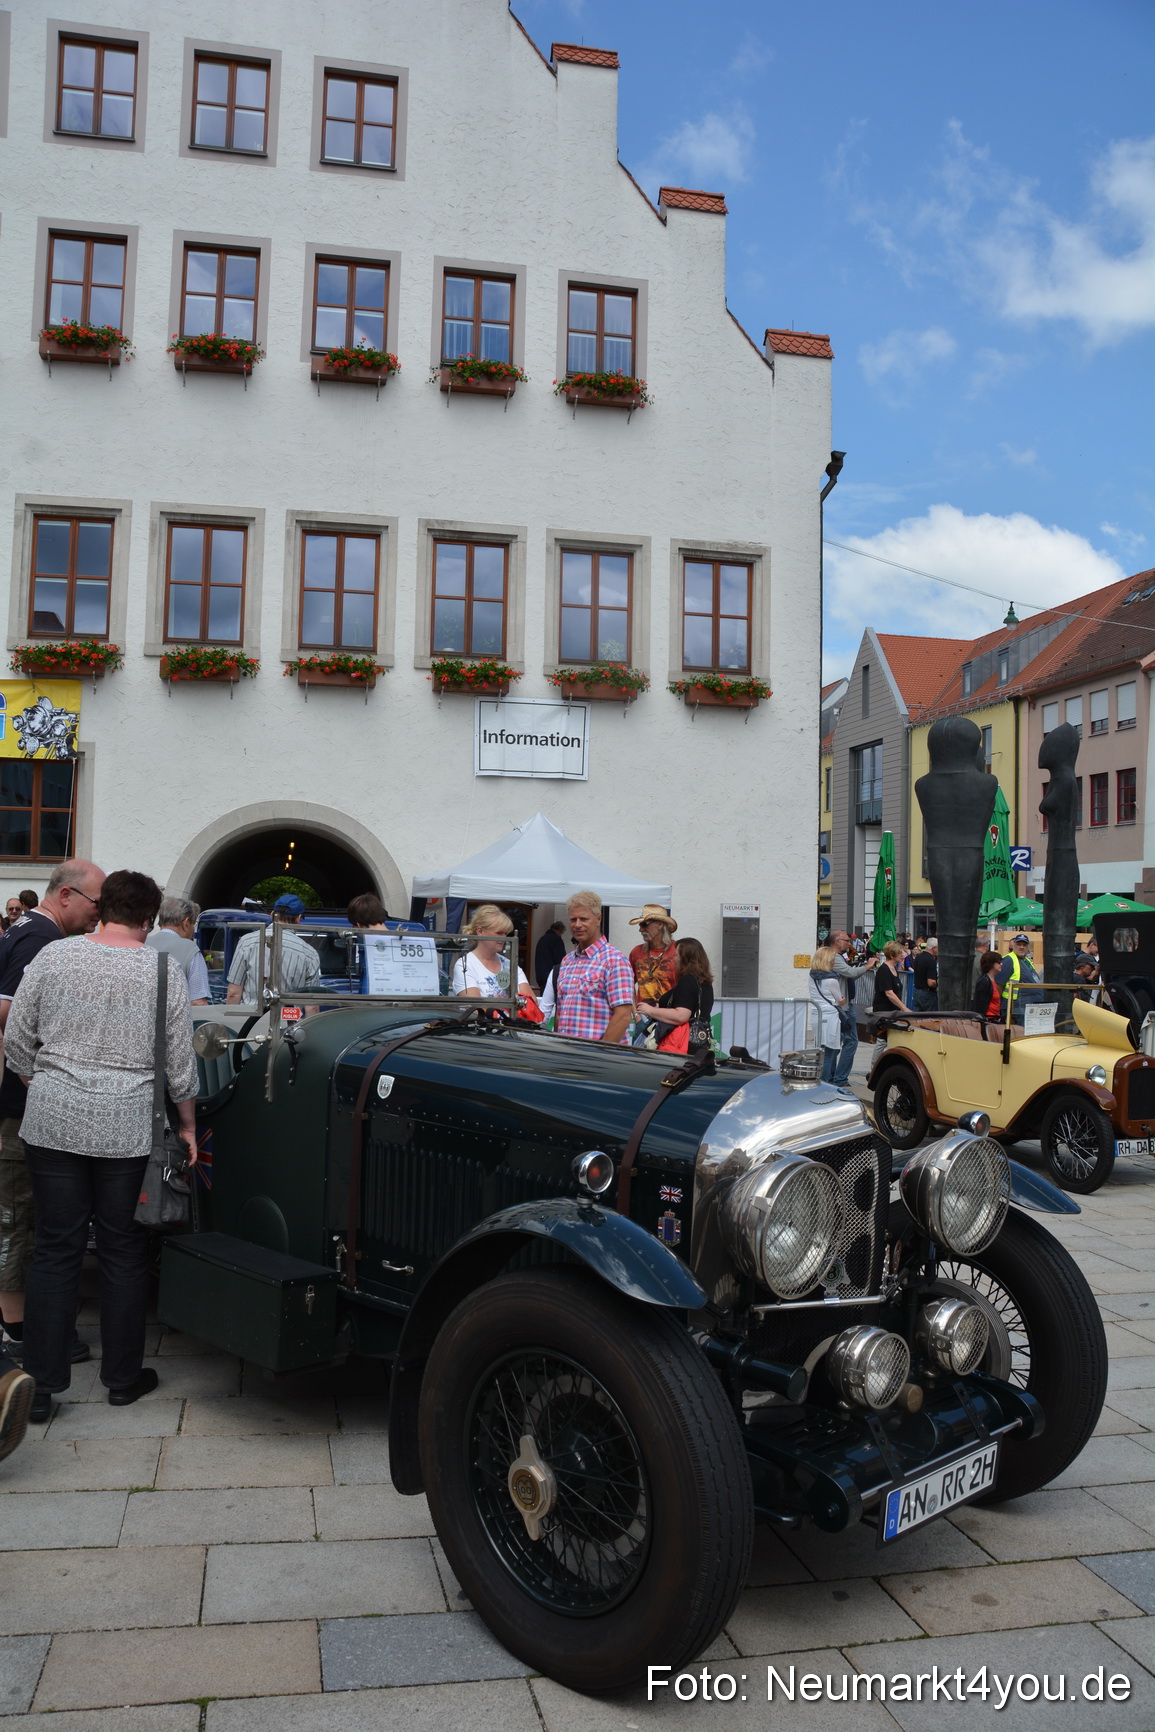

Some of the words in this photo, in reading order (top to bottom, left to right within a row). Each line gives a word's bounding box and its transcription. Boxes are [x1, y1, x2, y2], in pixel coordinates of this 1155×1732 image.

[483, 729, 581, 748] Information
[401, 944, 424, 957] 558
[1118, 1142, 1130, 1154] RH
[899, 1483, 928, 1528] AN
[940, 1464, 967, 1506] RR
[969, 1450, 996, 1490] 2H
